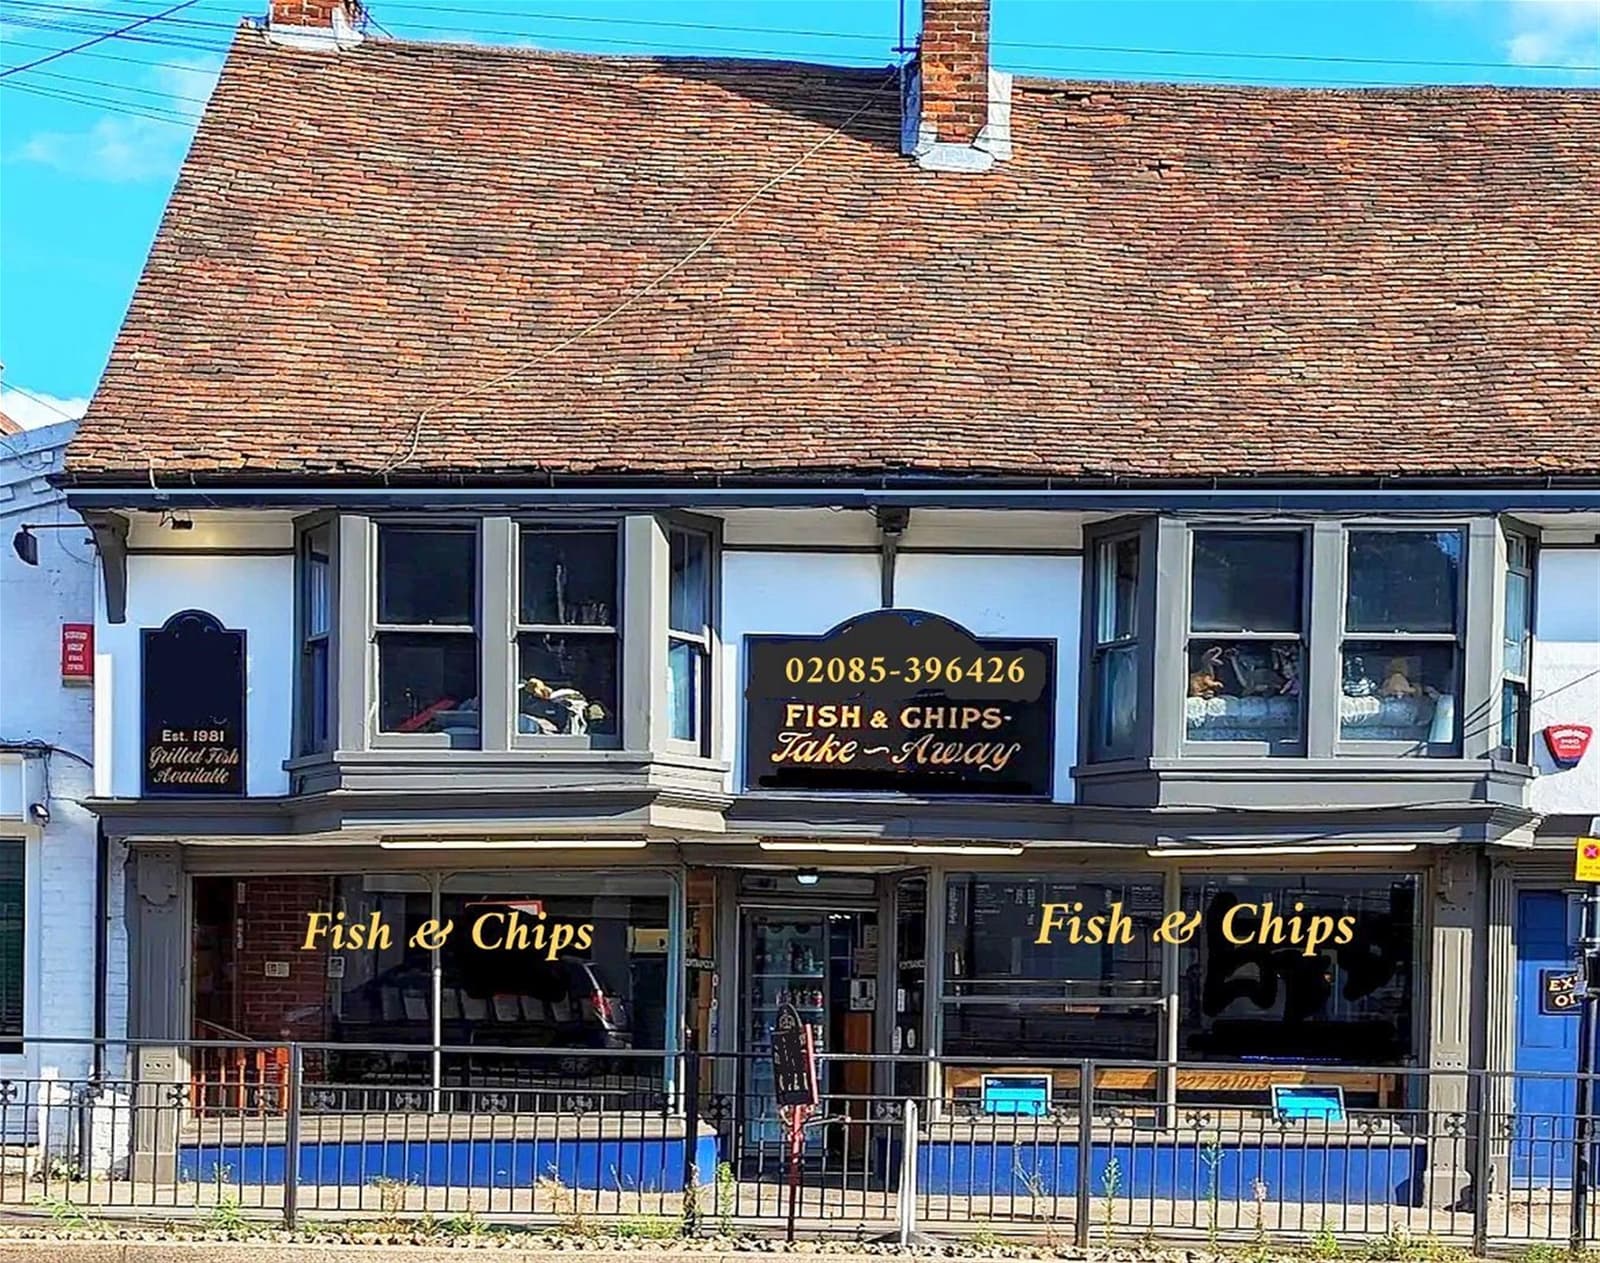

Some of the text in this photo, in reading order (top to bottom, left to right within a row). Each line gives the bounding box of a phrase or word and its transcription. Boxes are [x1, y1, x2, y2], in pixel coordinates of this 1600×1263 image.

[785, 656, 1025, 683] 02085-396426
[785, 704, 861, 728] FISH
[869, 710, 889, 729] &
[161, 729, 224, 742] Est. 1981
[149, 745, 239, 769] Grilled Fish
[891, 733, 1021, 773] Away
[153, 767, 229, 784] Available
[301, 911, 595, 961] Fish & Chips
[1034, 902, 1135, 945] Fish
[1153, 910, 1202, 944] &
[1222, 902, 1357, 957] Chips
[1549, 976, 1578, 991] EX
